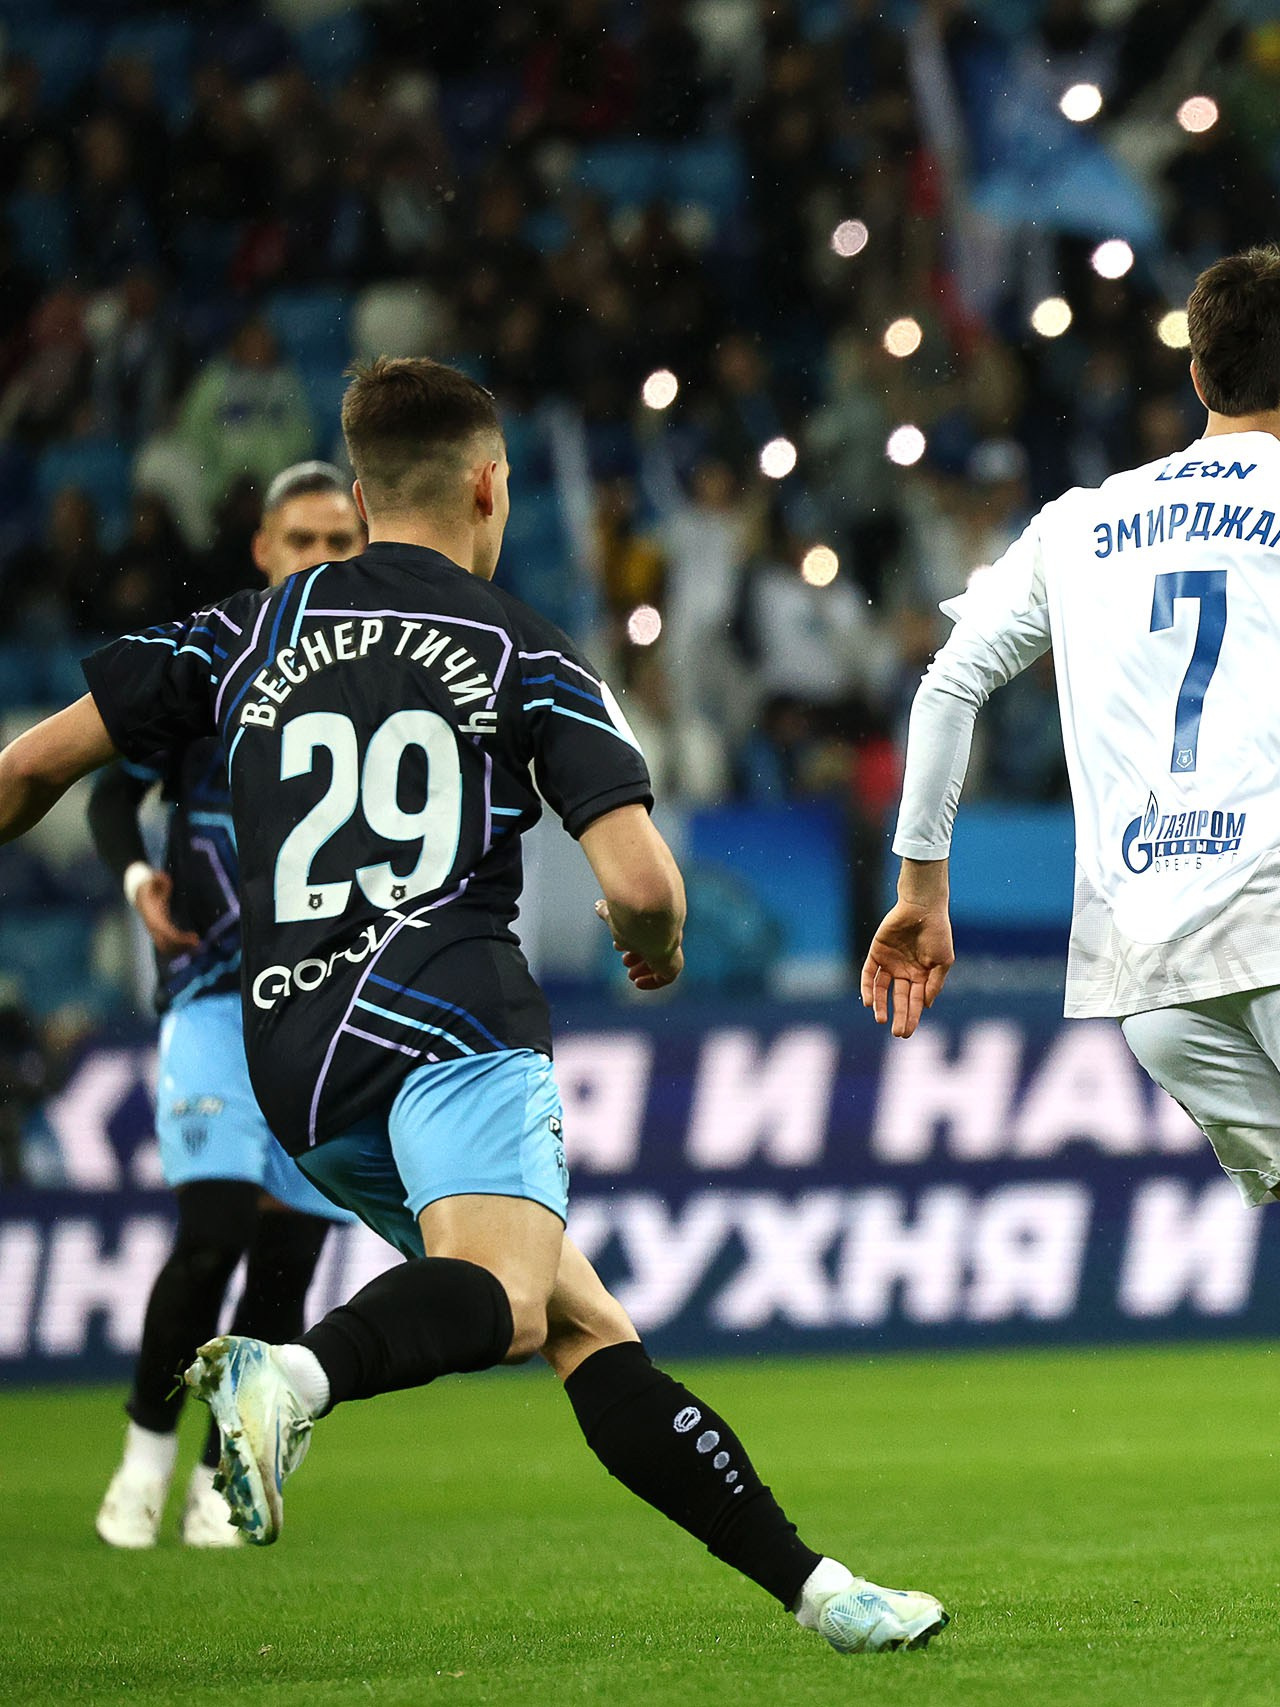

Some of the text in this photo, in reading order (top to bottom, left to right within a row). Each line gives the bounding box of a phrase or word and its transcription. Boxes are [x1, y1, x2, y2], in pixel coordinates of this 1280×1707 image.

[1154, 460, 1258, 482] LEON
[240, 618, 499, 734] ВЕСНЕР ТИЧИЧ
[1149, 569, 1228, 774] 7
[274, 708, 463, 924] 29
[1154, 853, 1239, 874] ОРЕНБГ
[1156, 809, 1247, 840] ГАЗПРОМ
[683, 1023, 839, 1170] И
[1114, 1174, 1263, 1318] И
